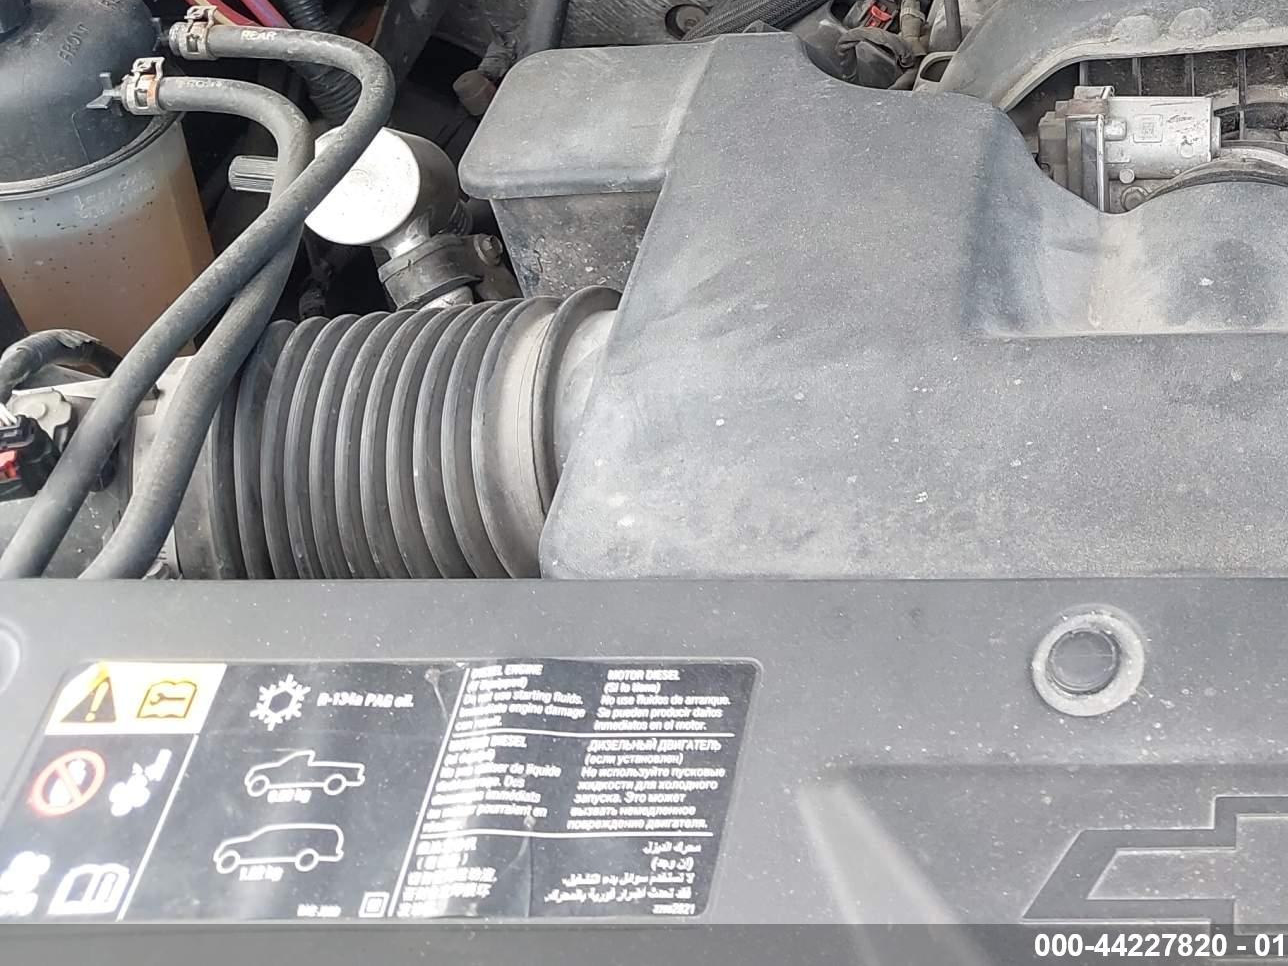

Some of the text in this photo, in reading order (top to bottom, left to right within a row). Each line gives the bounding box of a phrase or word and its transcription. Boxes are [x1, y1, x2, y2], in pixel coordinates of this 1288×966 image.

[240, 29, 277, 41] REAR
[608, 669, 681, 680] MOTOR DIESEL
[513, 690, 552, 703] starting
[509, 703, 543, 715] engine
[545, 705, 586, 719] damage
[650, 707, 692, 719] producir
[658, 739, 722, 752] ДВИГАТЕЛЬ
[504, 775, 525, 788] Des
